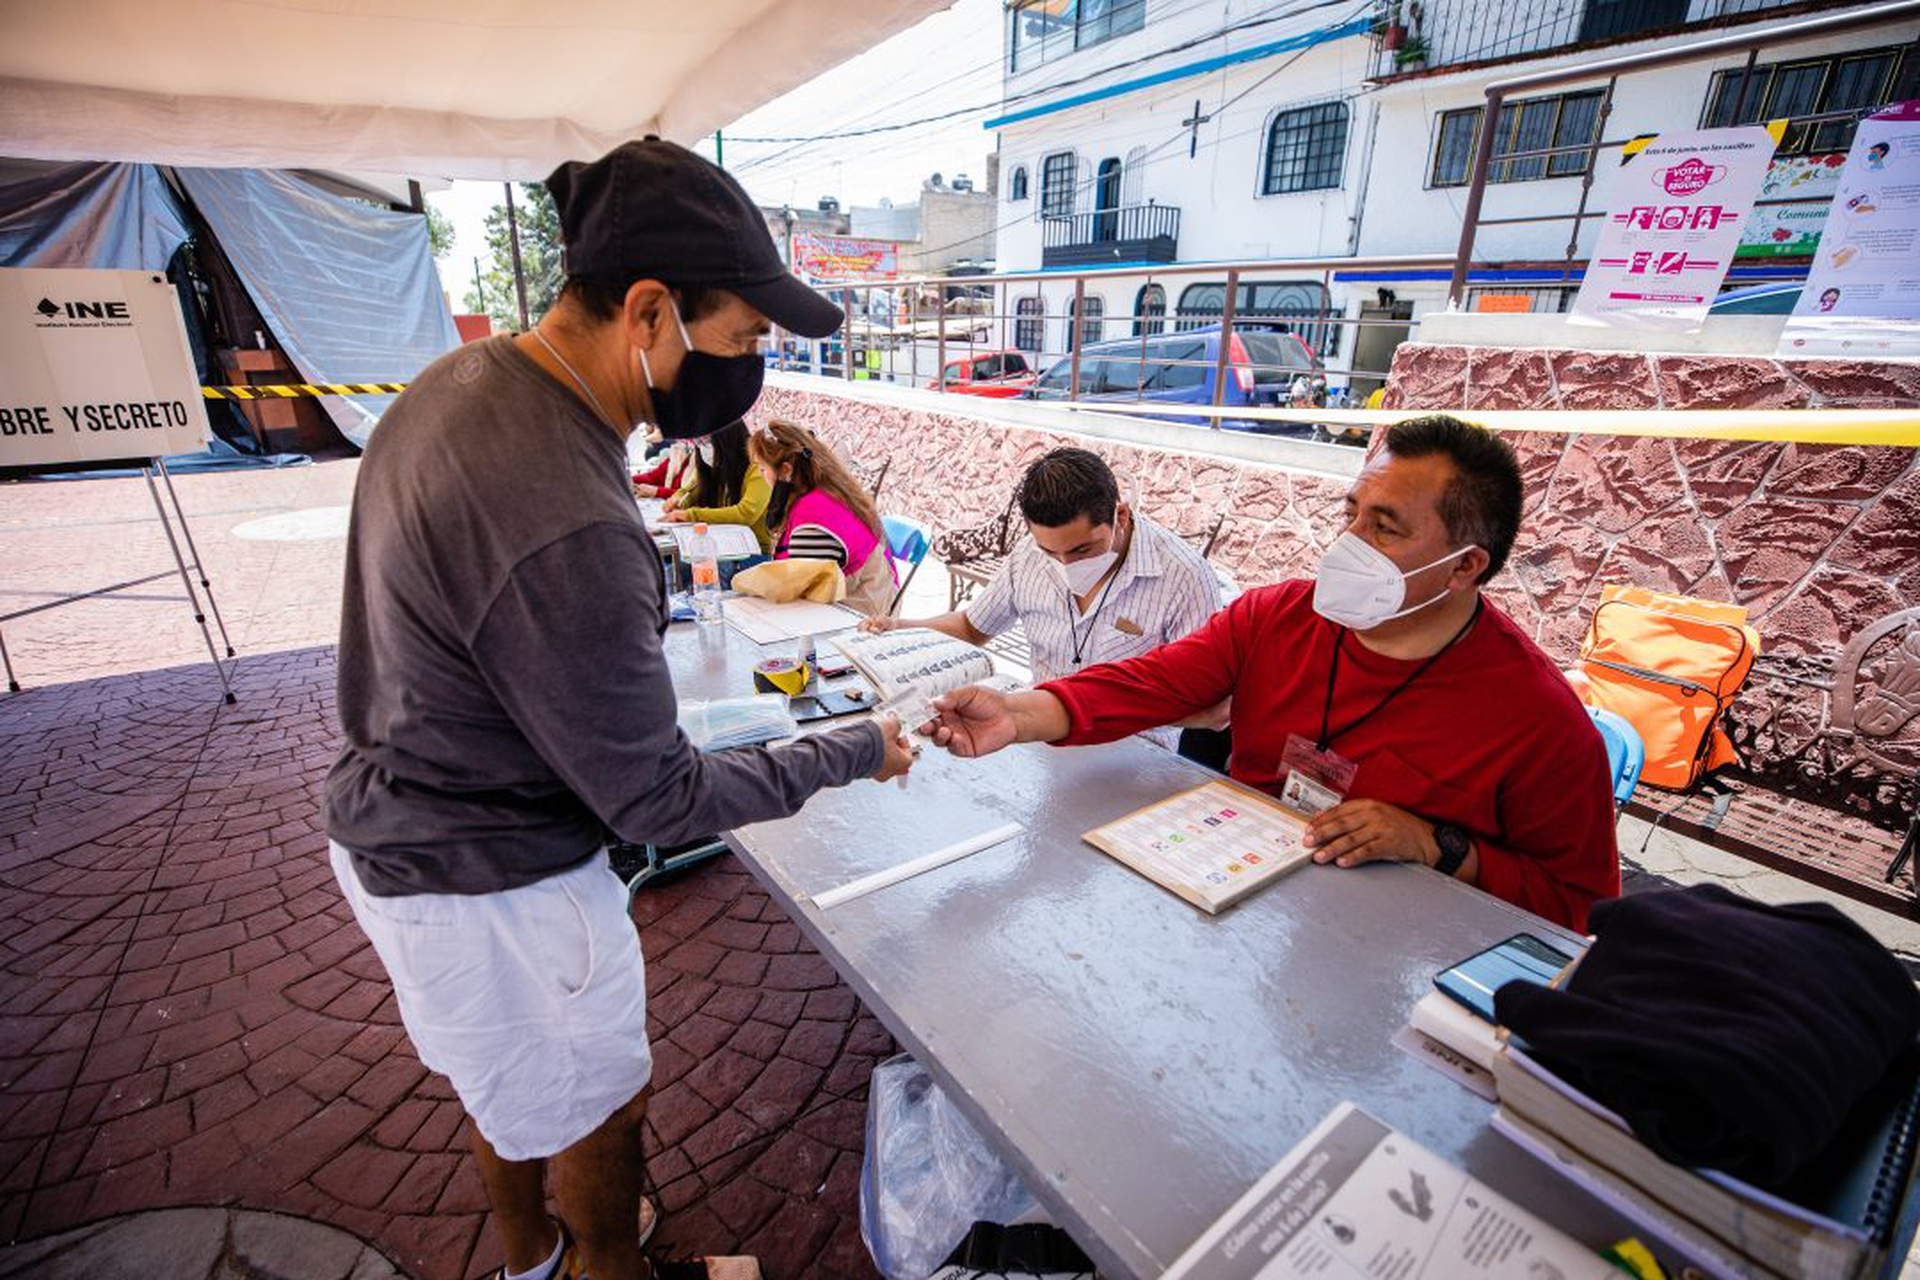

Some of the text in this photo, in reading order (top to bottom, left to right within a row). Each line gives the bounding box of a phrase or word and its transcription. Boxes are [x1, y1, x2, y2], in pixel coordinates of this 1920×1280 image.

[1673, 166, 1706, 177] VOTAR
[1667, 180, 1705, 191] SEGURO
[65, 302, 130, 319] INE
[0, 407, 54, 436] BRE
[83, 401, 188, 432] SECRETO
